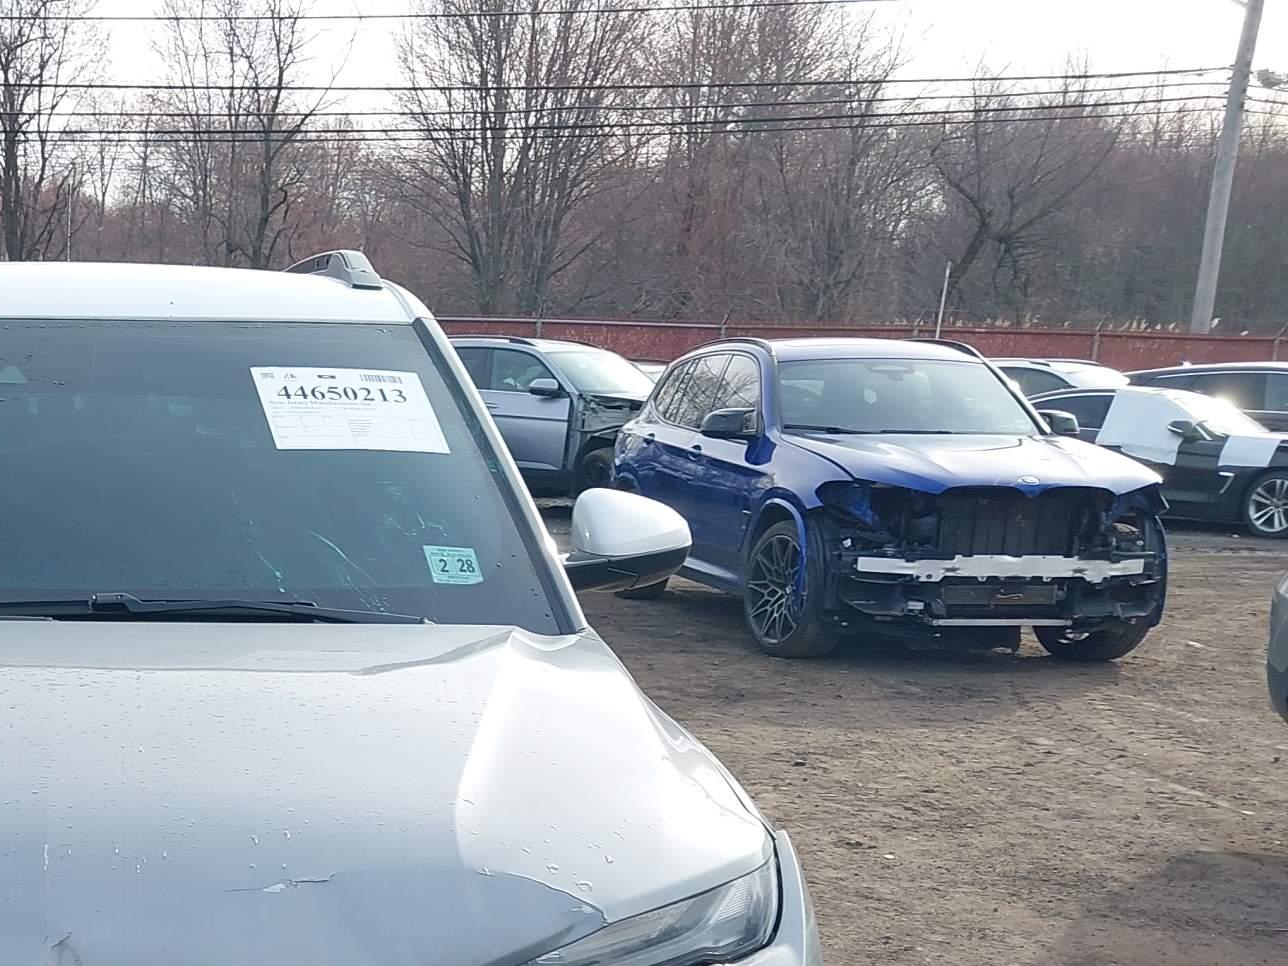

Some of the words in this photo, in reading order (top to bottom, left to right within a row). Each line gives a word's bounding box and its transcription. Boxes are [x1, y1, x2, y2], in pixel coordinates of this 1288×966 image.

[277, 385, 407, 403] 44650213
[438, 558, 450, 573] 2
[456, 558, 476, 574] 28
